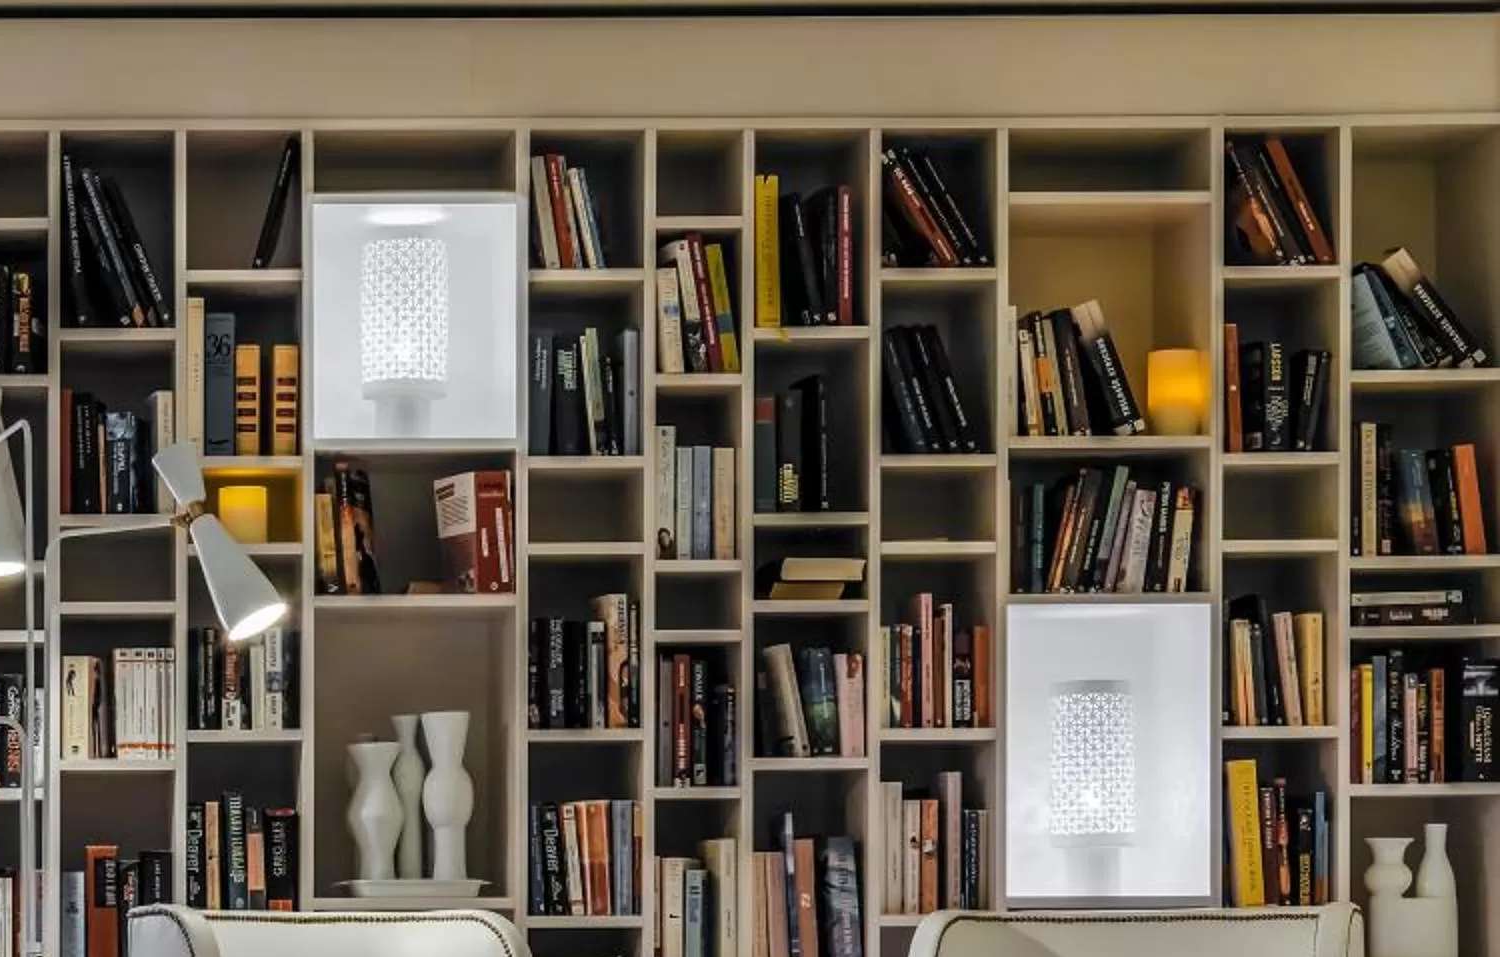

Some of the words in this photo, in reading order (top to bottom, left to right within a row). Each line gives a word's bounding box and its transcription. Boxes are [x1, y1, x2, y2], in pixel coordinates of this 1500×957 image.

[206, 333, 231, 358] 36
[187, 830, 202, 872] Deaver
[544, 829, 558, 873] Deaver
